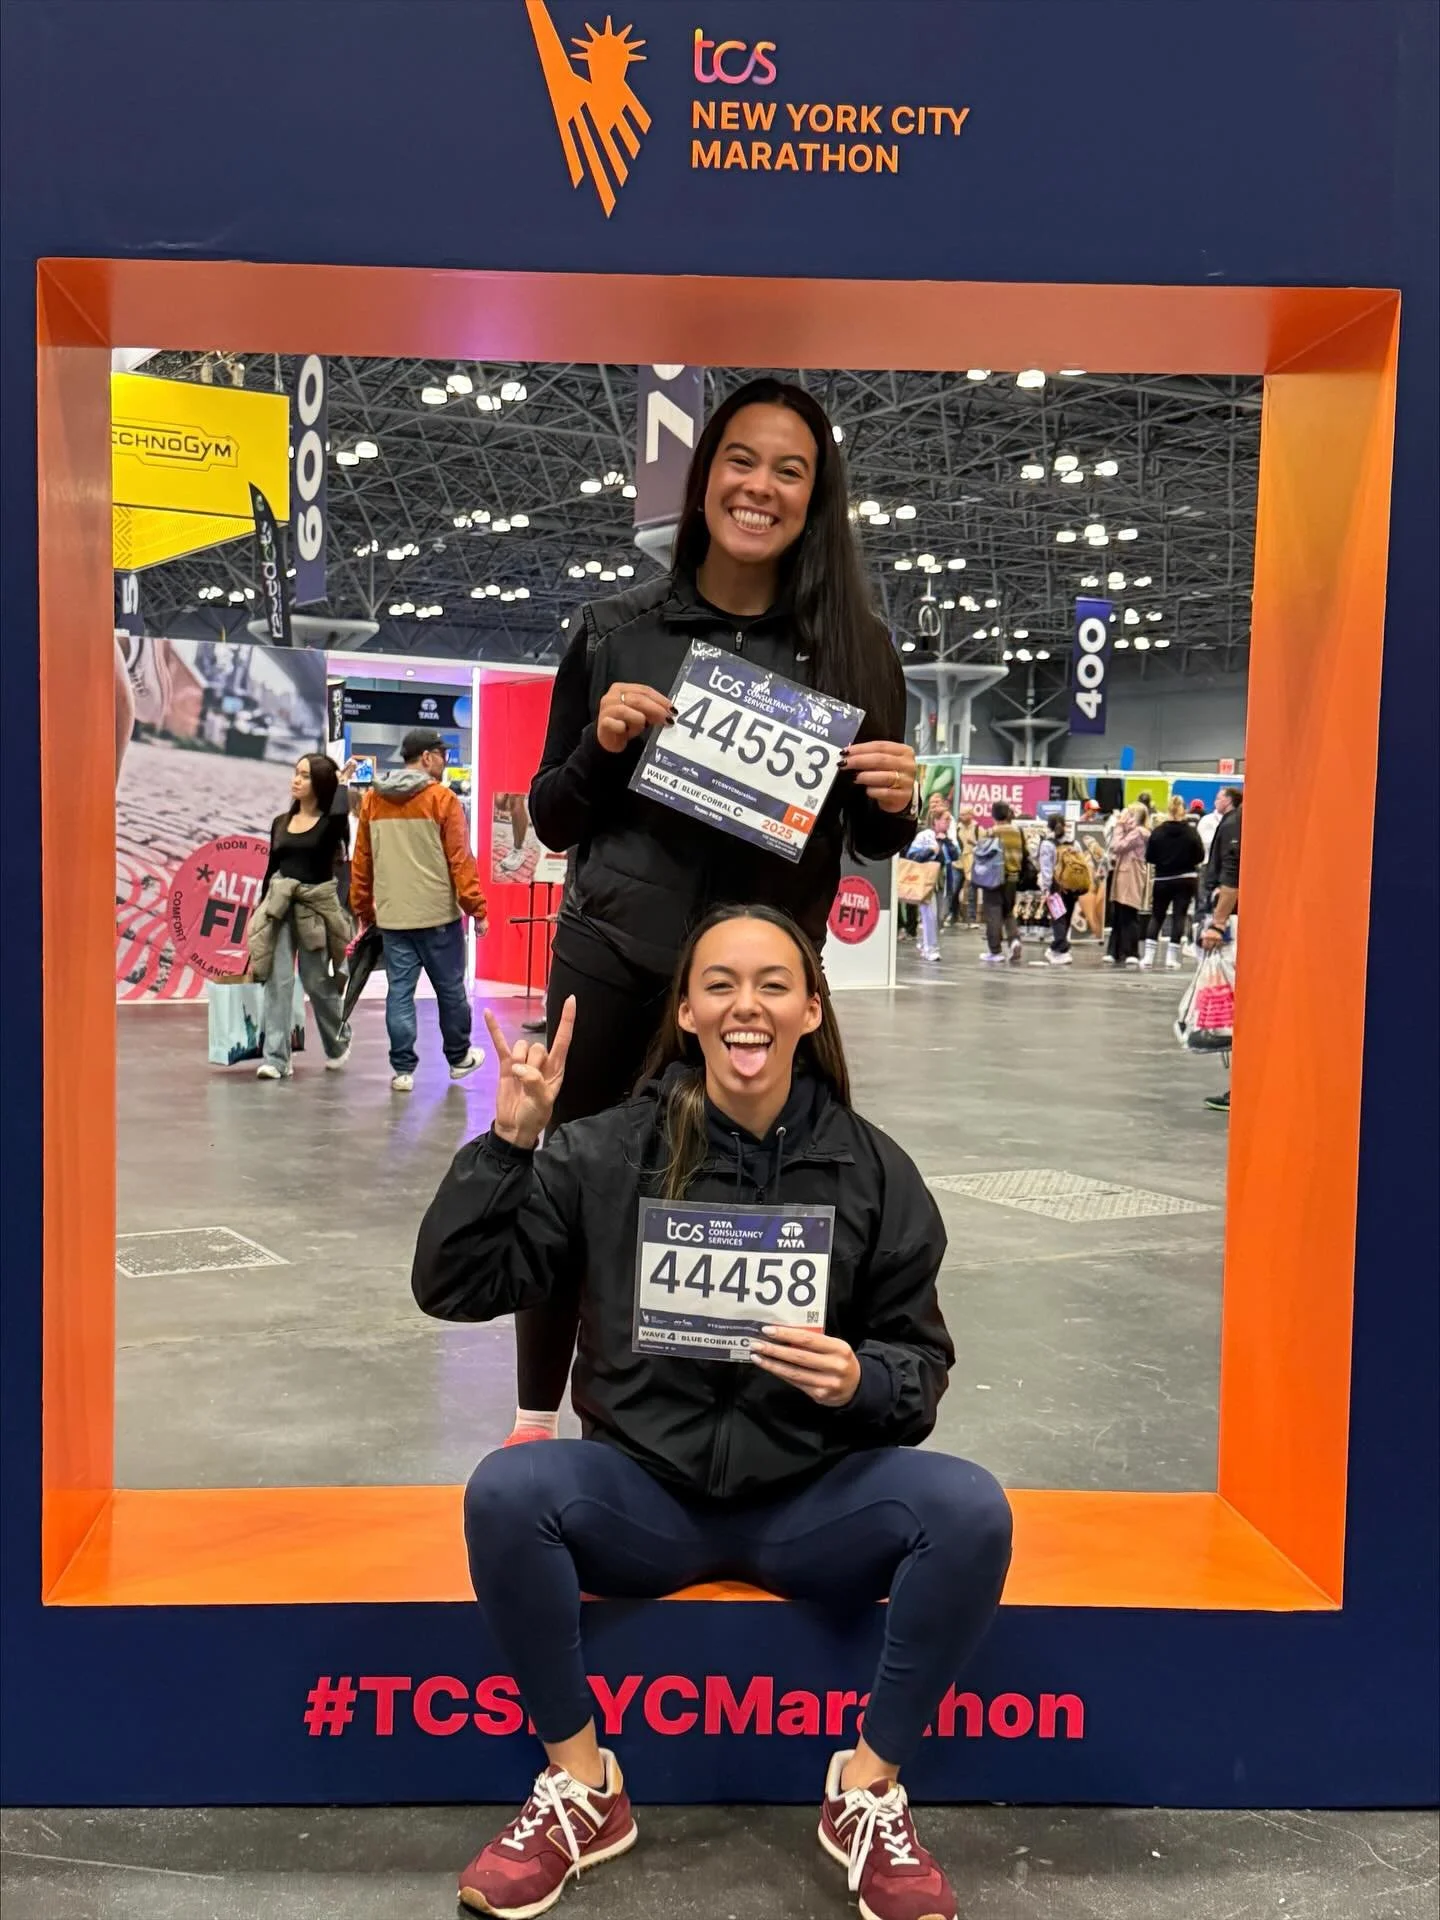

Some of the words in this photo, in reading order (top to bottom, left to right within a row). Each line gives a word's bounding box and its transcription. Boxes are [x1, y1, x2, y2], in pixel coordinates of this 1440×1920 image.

[694, 28, 777, 85] tcs
[691, 100, 777, 131] NEW
[786, 103, 883, 134] YORK
[891, 106, 970, 136] CITY
[691, 140, 900, 173] MARATHON
[296, 354, 324, 561] 600
[1075, 617, 1106, 719] 400
[709, 666, 745, 697] tcs
[744, 696, 773, 712] SERVICES
[746, 689, 795, 713] CONSULTANCY
[803, 720, 830, 737] TATA
[677, 697, 830, 790] 44553
[646, 768, 670, 784] WAVE
[670, 778, 679, 789] 4
[681, 785, 702, 798] BLUE
[701, 794, 732, 812] CORRAL
[733, 807, 742, 816] C
[960, 783, 1024, 802] WABLE
[762, 819, 793, 839] 2025
[791, 812, 810, 827] FT
[216, 840, 248, 851] ROOM
[254, 844, 270, 856] FO
[840, 892, 870, 909] ALTRA
[172, 891, 187, 942] COMFORT
[200, 897, 252, 945] FI
[838, 905, 869, 928] FIT
[666, 1217, 705, 1243] tcs
[708, 1228, 764, 1239] CONSULTANCY
[709, 1220, 733, 1228] TATA
[708, 1237, 743, 1246] SERVICES
[777, 1239, 806, 1248] TATA
[649, 1250, 817, 1307] 44458
[641, 1330, 666, 1339] WAVE
[667, 1331, 676, 1341] 4
[681, 1335, 702, 1343] BLUE
[703, 1336, 738, 1347] CORRAL
[740, 1338, 750, 1347] C
[304, 1675, 1085, 1740] #TCSYCMarhon
